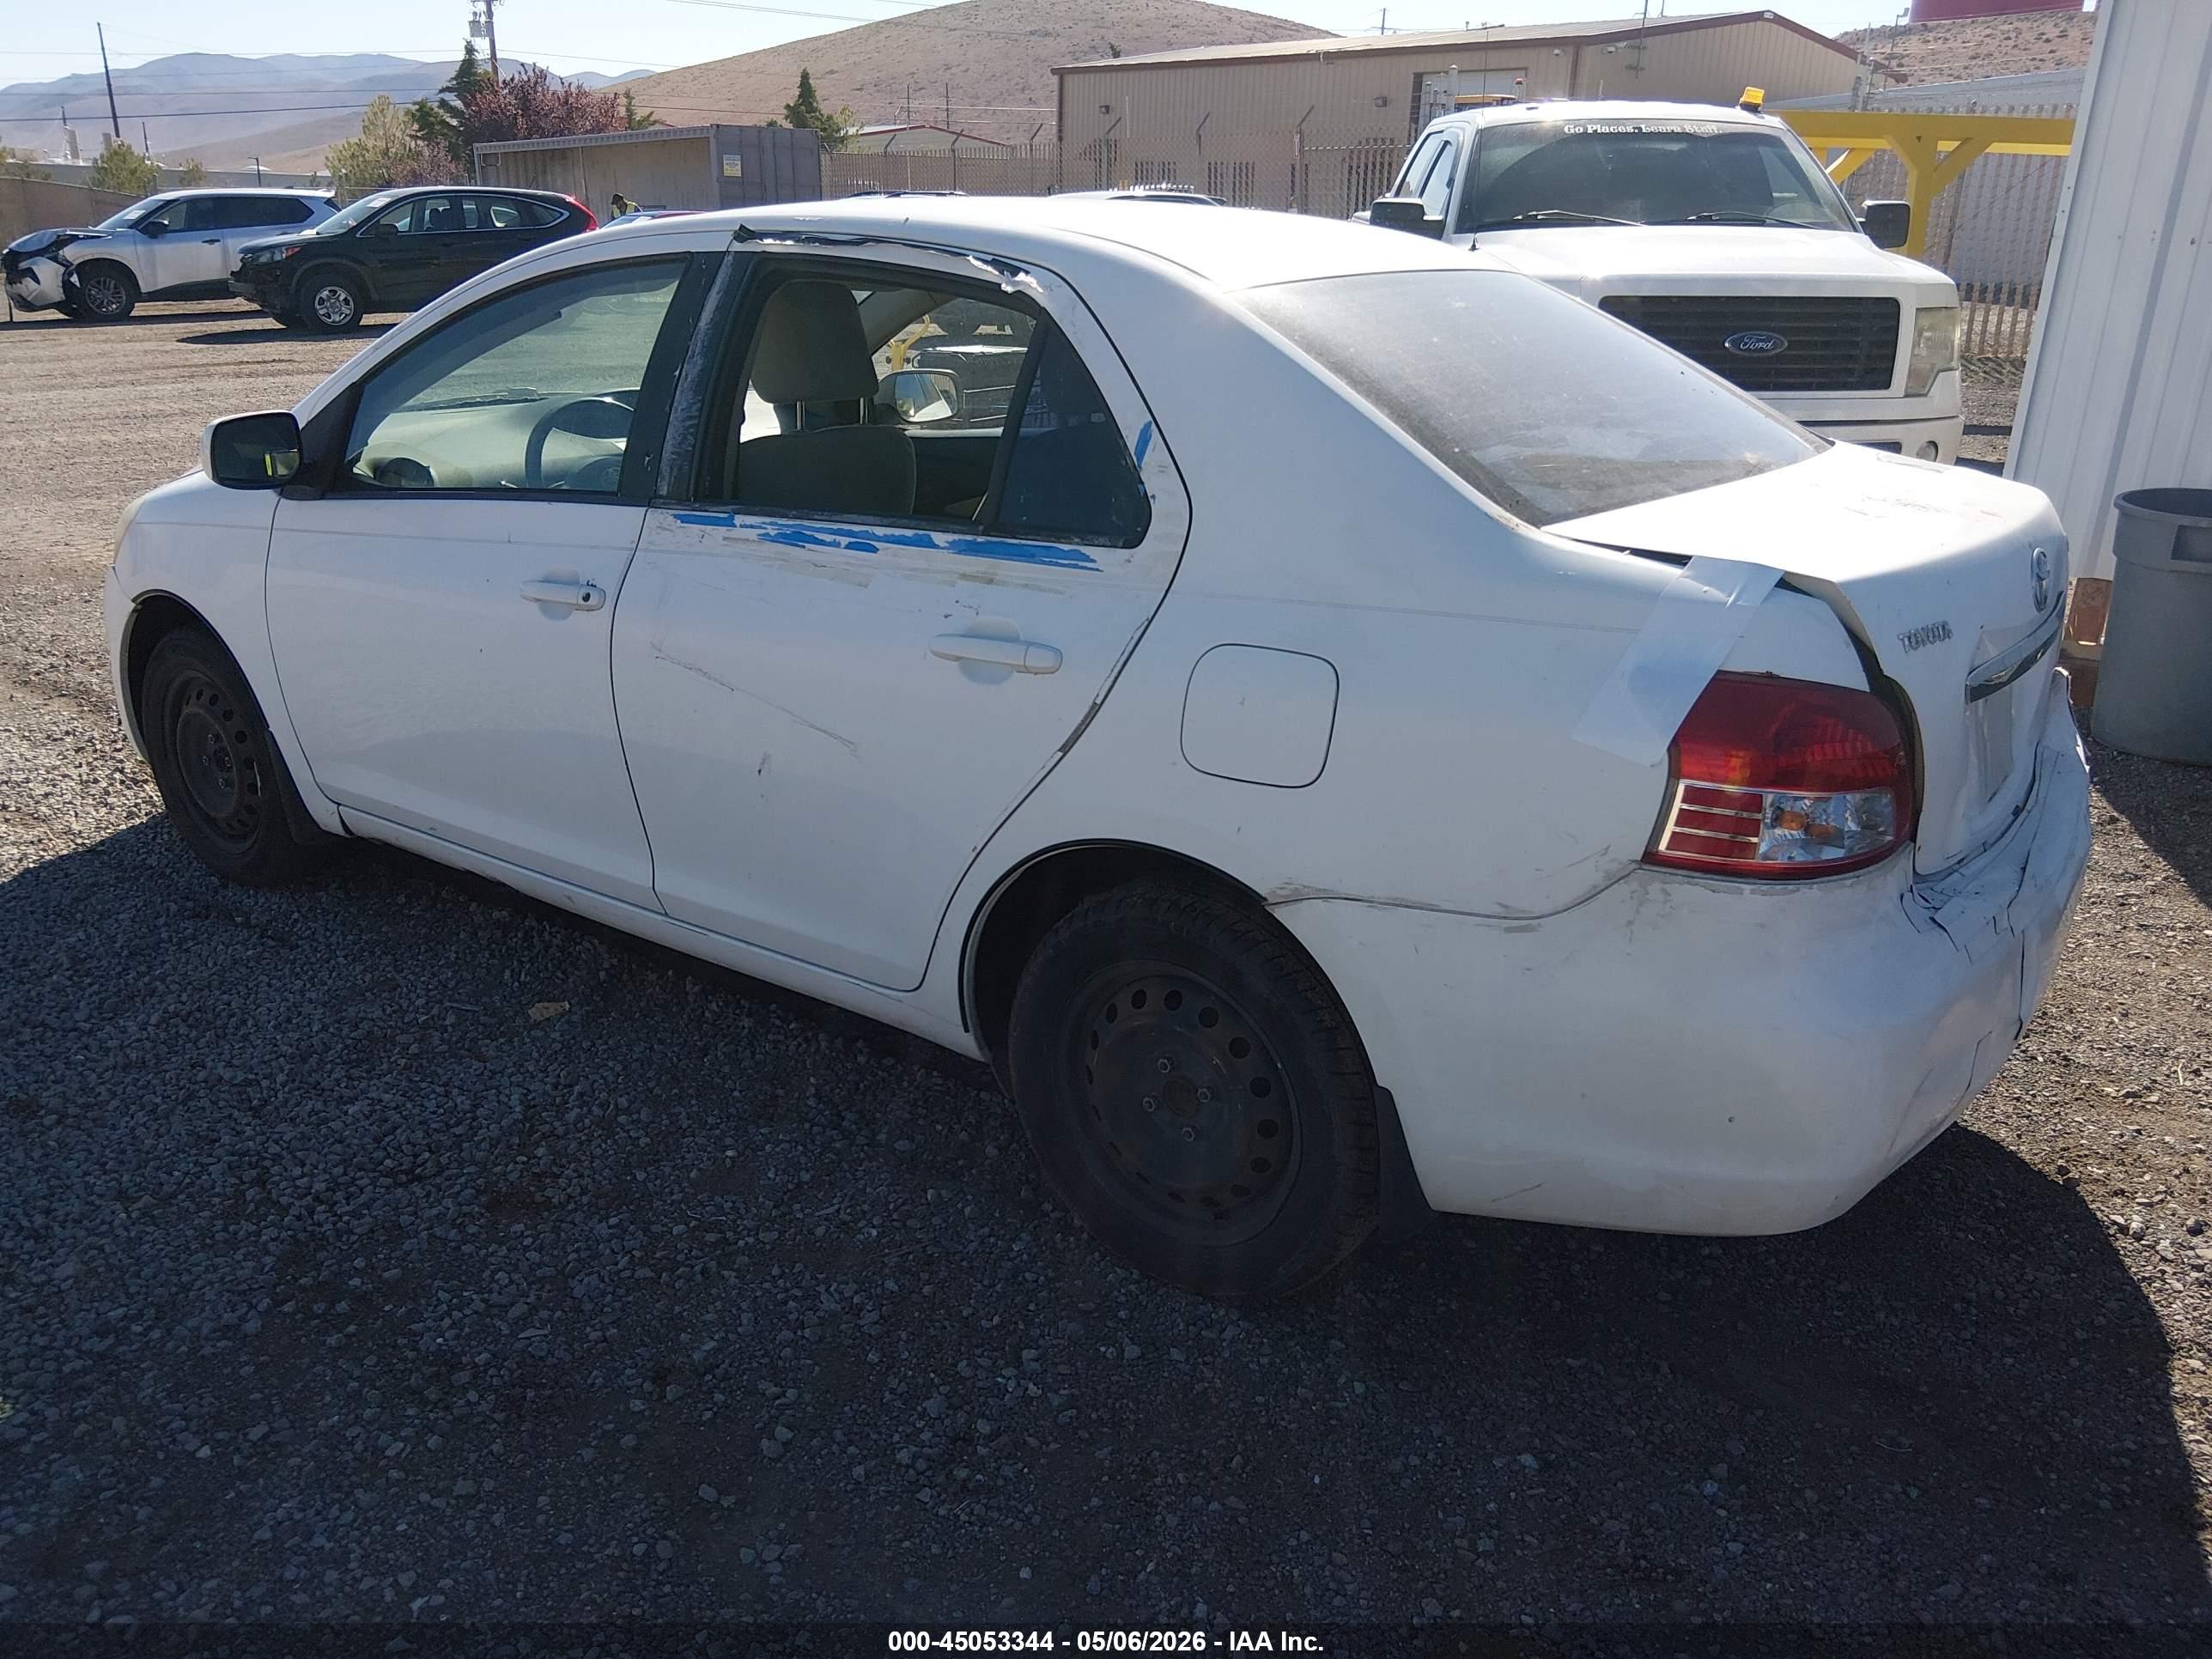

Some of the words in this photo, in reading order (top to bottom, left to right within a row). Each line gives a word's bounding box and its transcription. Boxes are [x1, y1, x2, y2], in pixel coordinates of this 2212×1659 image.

[1564, 125, 1583, 134] Go
[1586, 124, 1638, 134] Places.
[1640, 124, 1682, 134] Learn
[1740, 336, 1774, 349] Ford
[1897, 620, 1954, 653] TOYOTA
